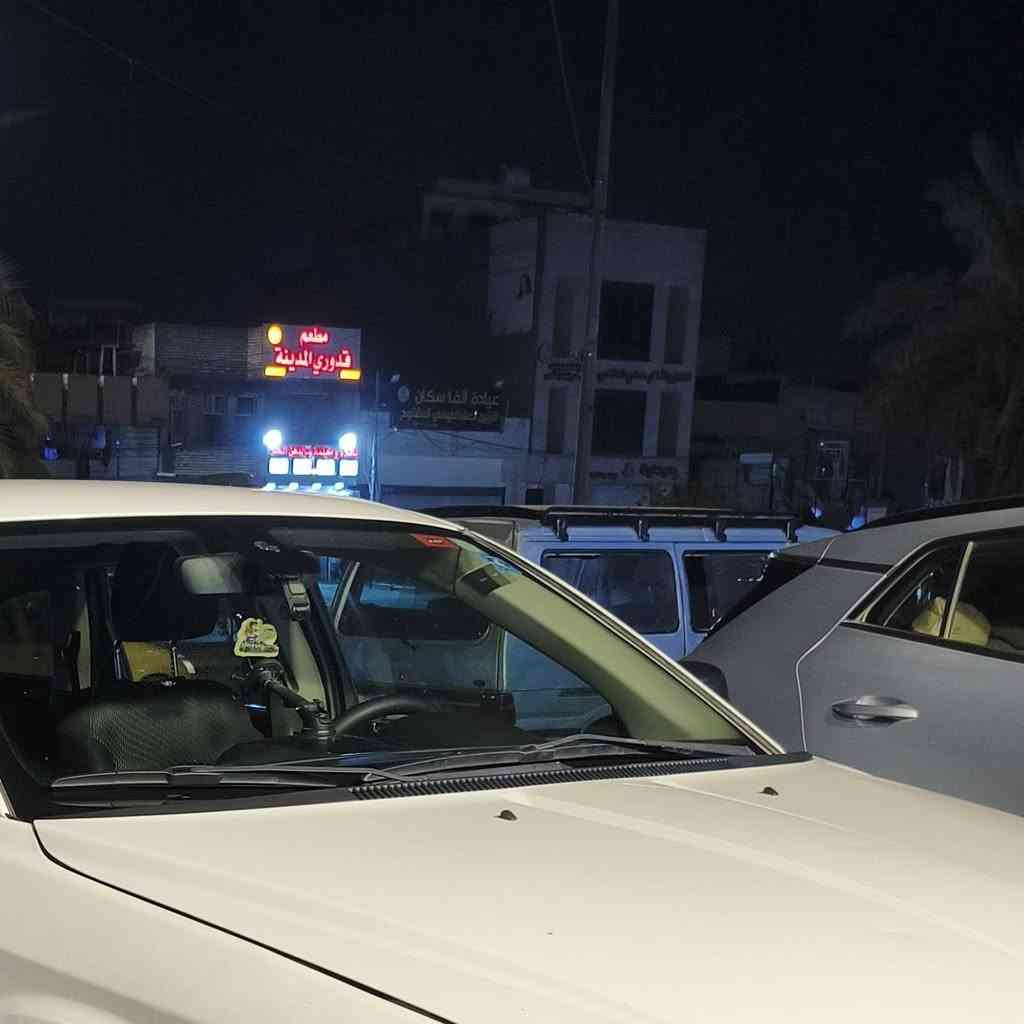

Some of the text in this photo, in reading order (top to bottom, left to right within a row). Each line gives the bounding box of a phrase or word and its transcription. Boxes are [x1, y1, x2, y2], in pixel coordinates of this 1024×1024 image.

[299, 327, 329, 345] مطعم
[274, 346, 352, 375] قدوري المدينة
